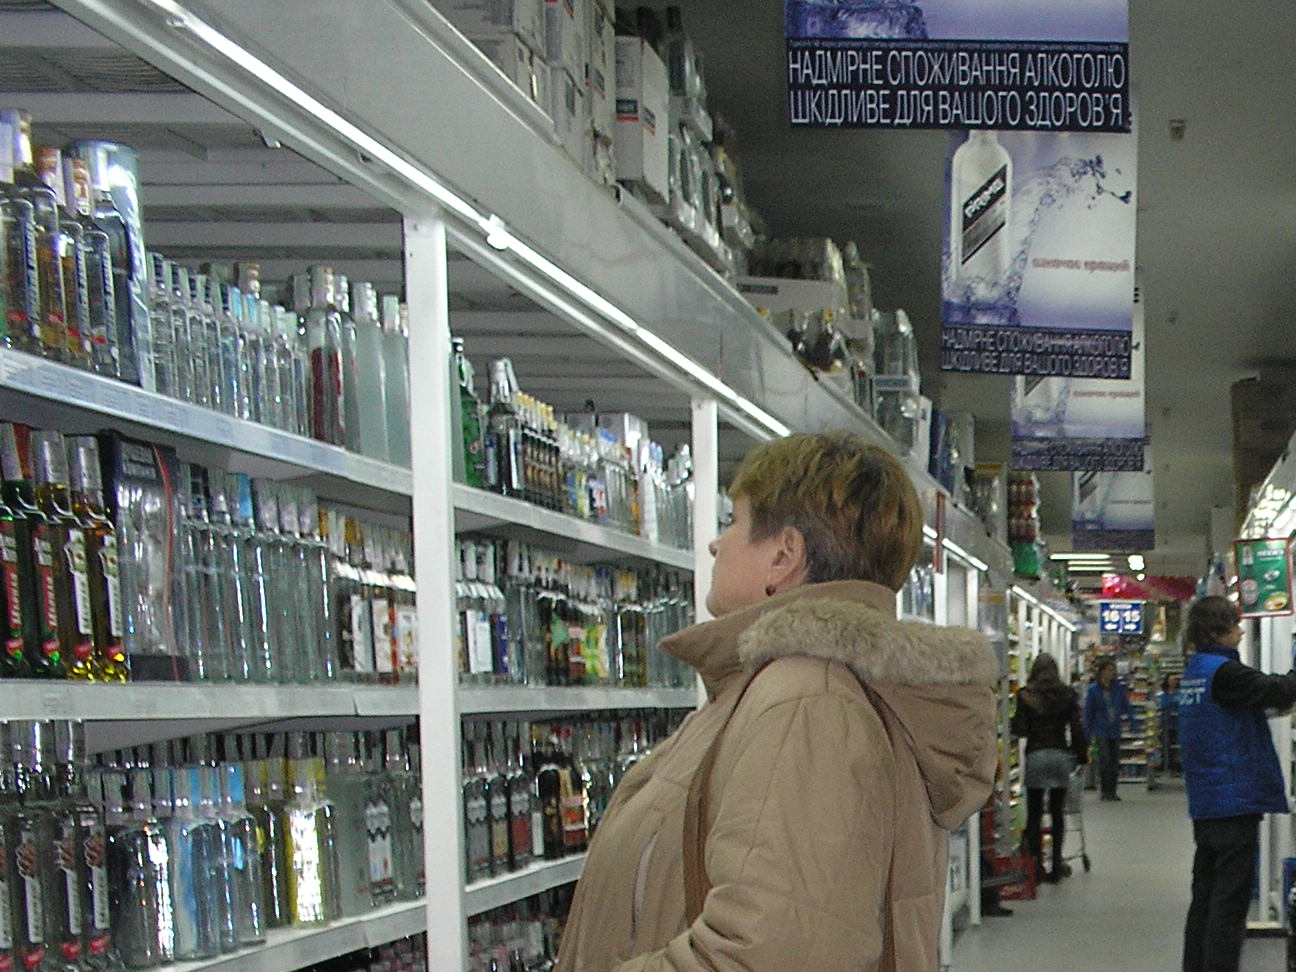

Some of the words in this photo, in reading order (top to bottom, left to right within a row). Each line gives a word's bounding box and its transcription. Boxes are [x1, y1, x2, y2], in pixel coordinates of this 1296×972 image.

[789, 50, 882, 85] НАДМІРНЕ
[888, 50, 1019, 86] СПОЖИВАННЯ
[1024, 53, 1125, 89] АЛКОГОЛЮ
[790, 89, 890, 125] ШКІДЛИВЕ
[894, 90, 933, 126] ДЛЯ
[939, 91, 1021, 126] ВАШОГО
[1026, 92, 1123, 128] ЗДОРОВ'Я
